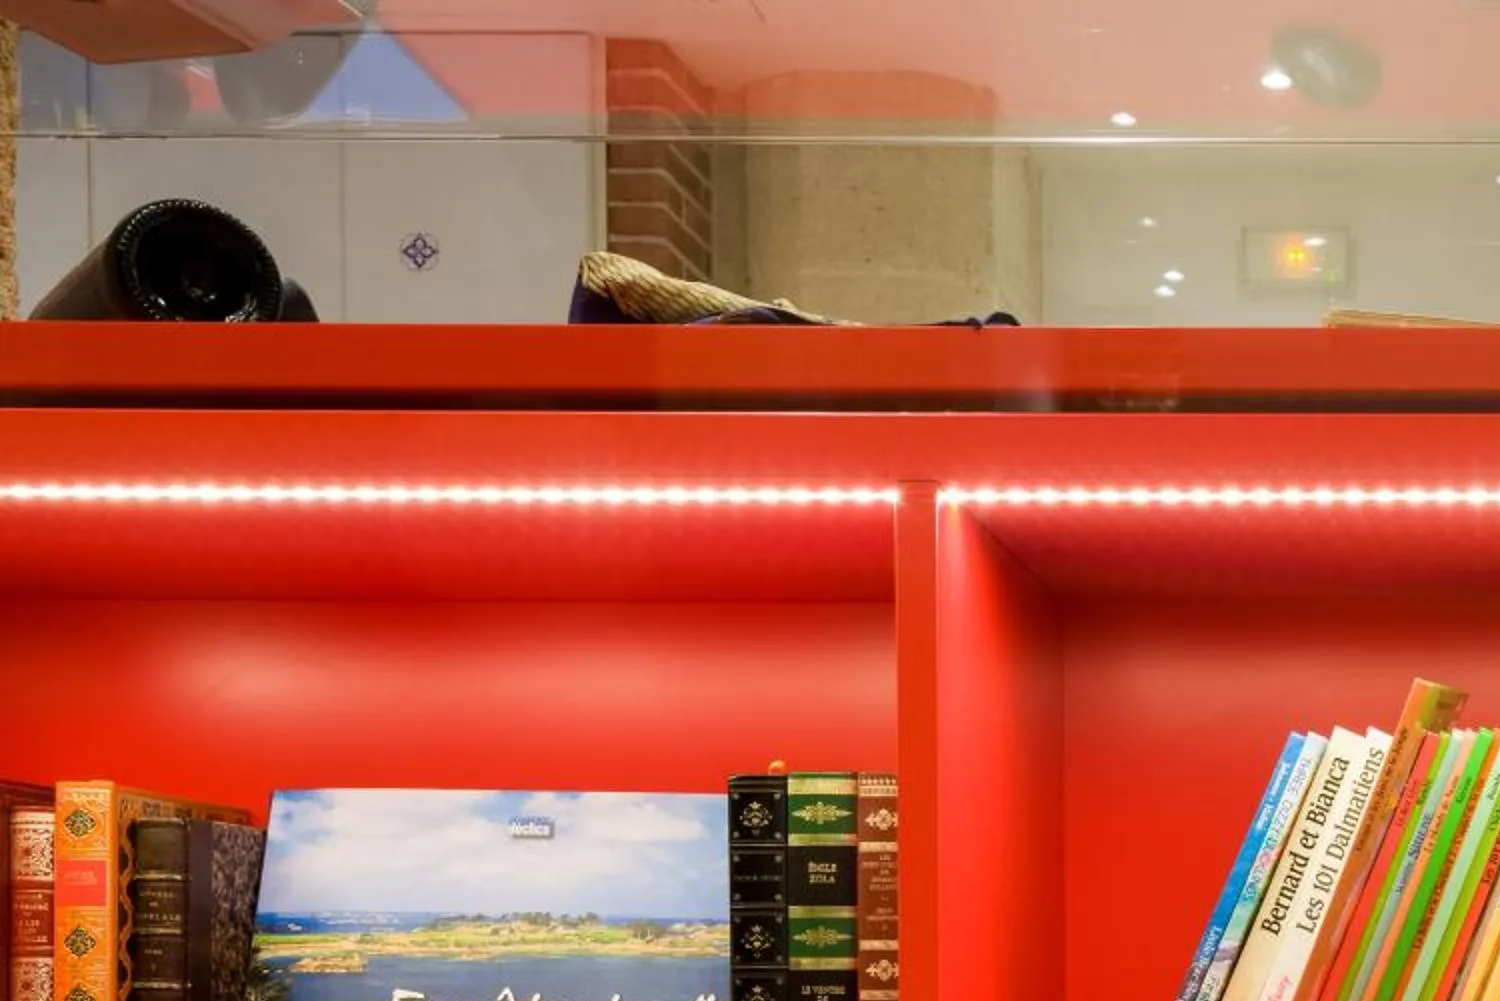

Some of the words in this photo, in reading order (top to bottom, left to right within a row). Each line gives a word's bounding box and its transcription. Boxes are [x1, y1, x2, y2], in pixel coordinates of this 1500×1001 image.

[1304, 753, 1350, 828] Bianca
[1323, 743, 1385, 861] Dalmatiens
[1296, 828, 1320, 851] et
[1258, 849, 1310, 937] Bernard
[1310, 862, 1337, 893] 101
[1295, 894, 1325, 934] Les
